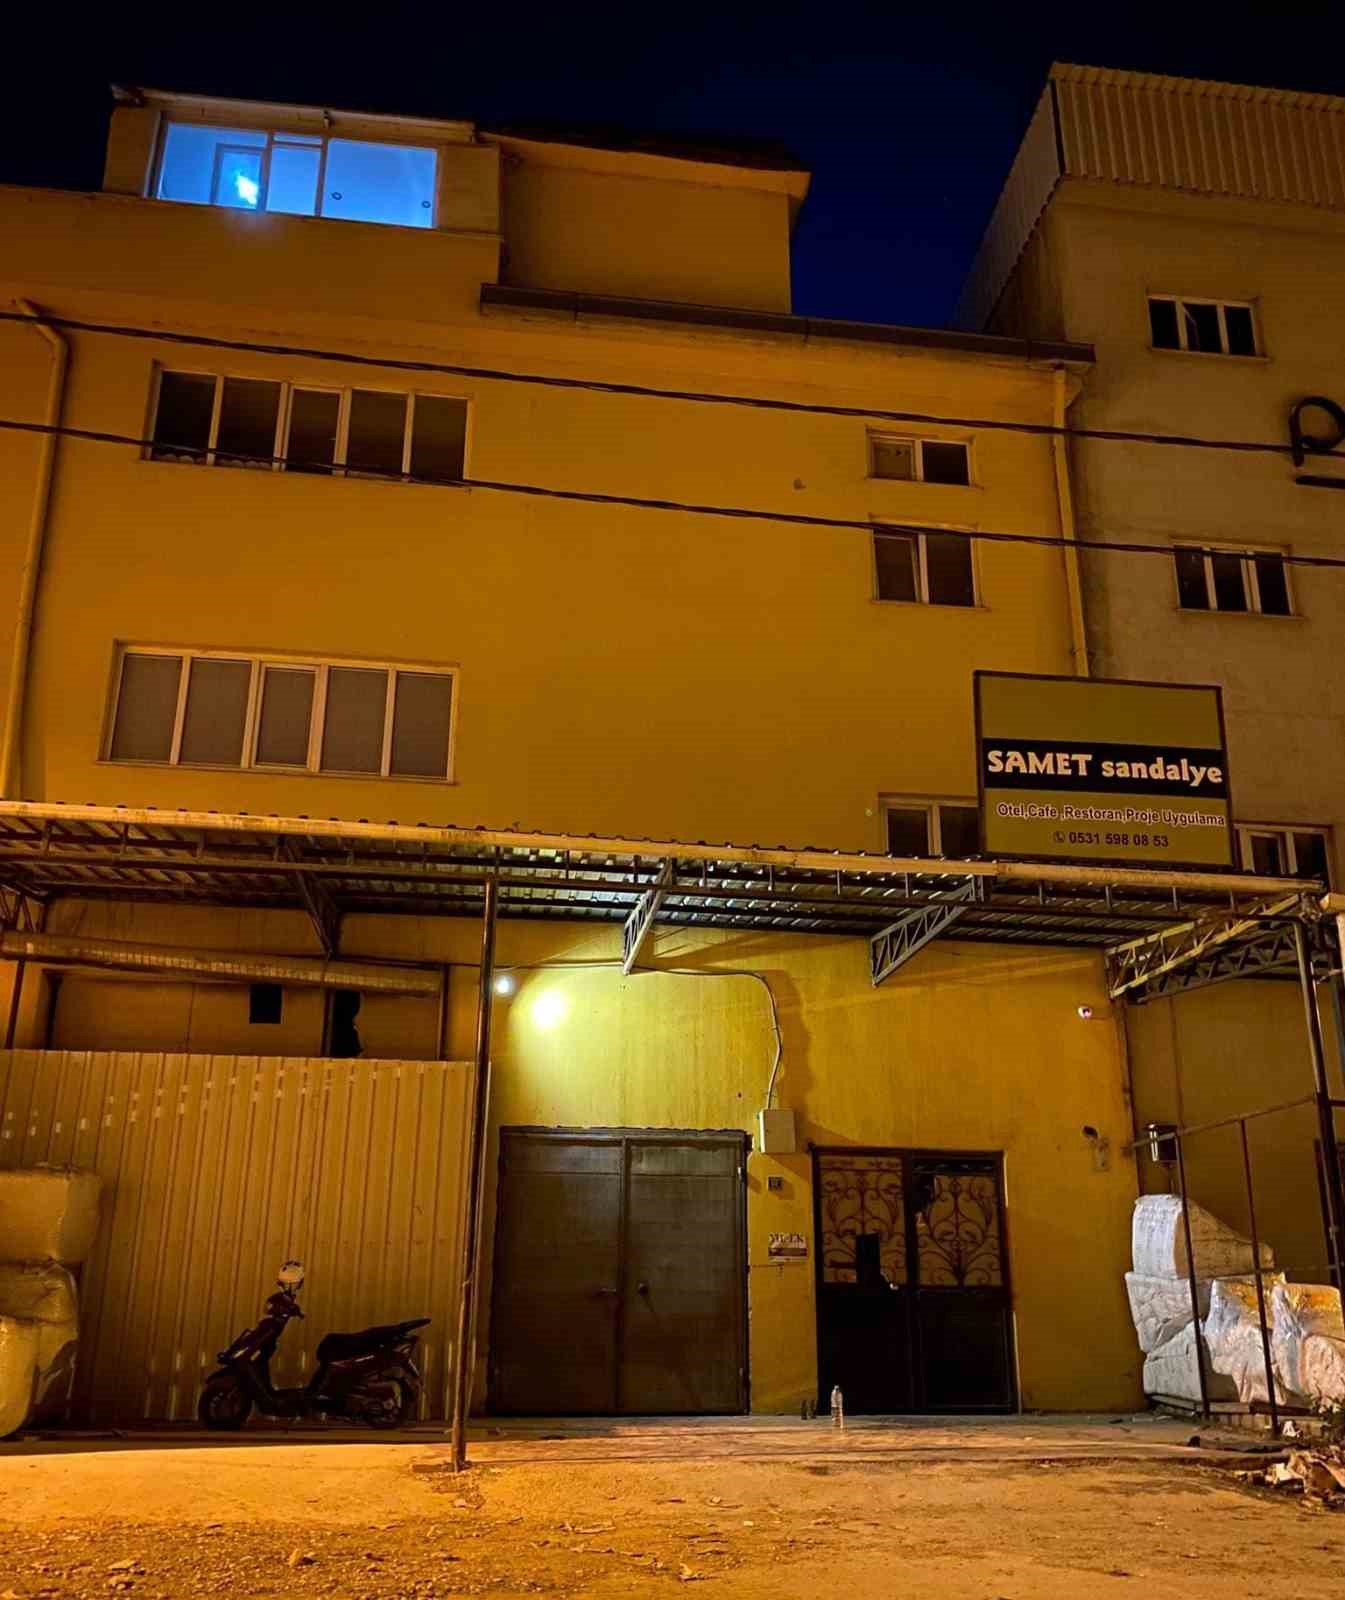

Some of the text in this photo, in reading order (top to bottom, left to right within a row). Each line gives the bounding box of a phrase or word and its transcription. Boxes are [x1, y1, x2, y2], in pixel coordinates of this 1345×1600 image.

[987, 750, 1223, 787] SAMET sandalye
[1162, 810, 1225, 828] Uygulama
[1069, 831, 1169, 848] 0531 598 08 53
